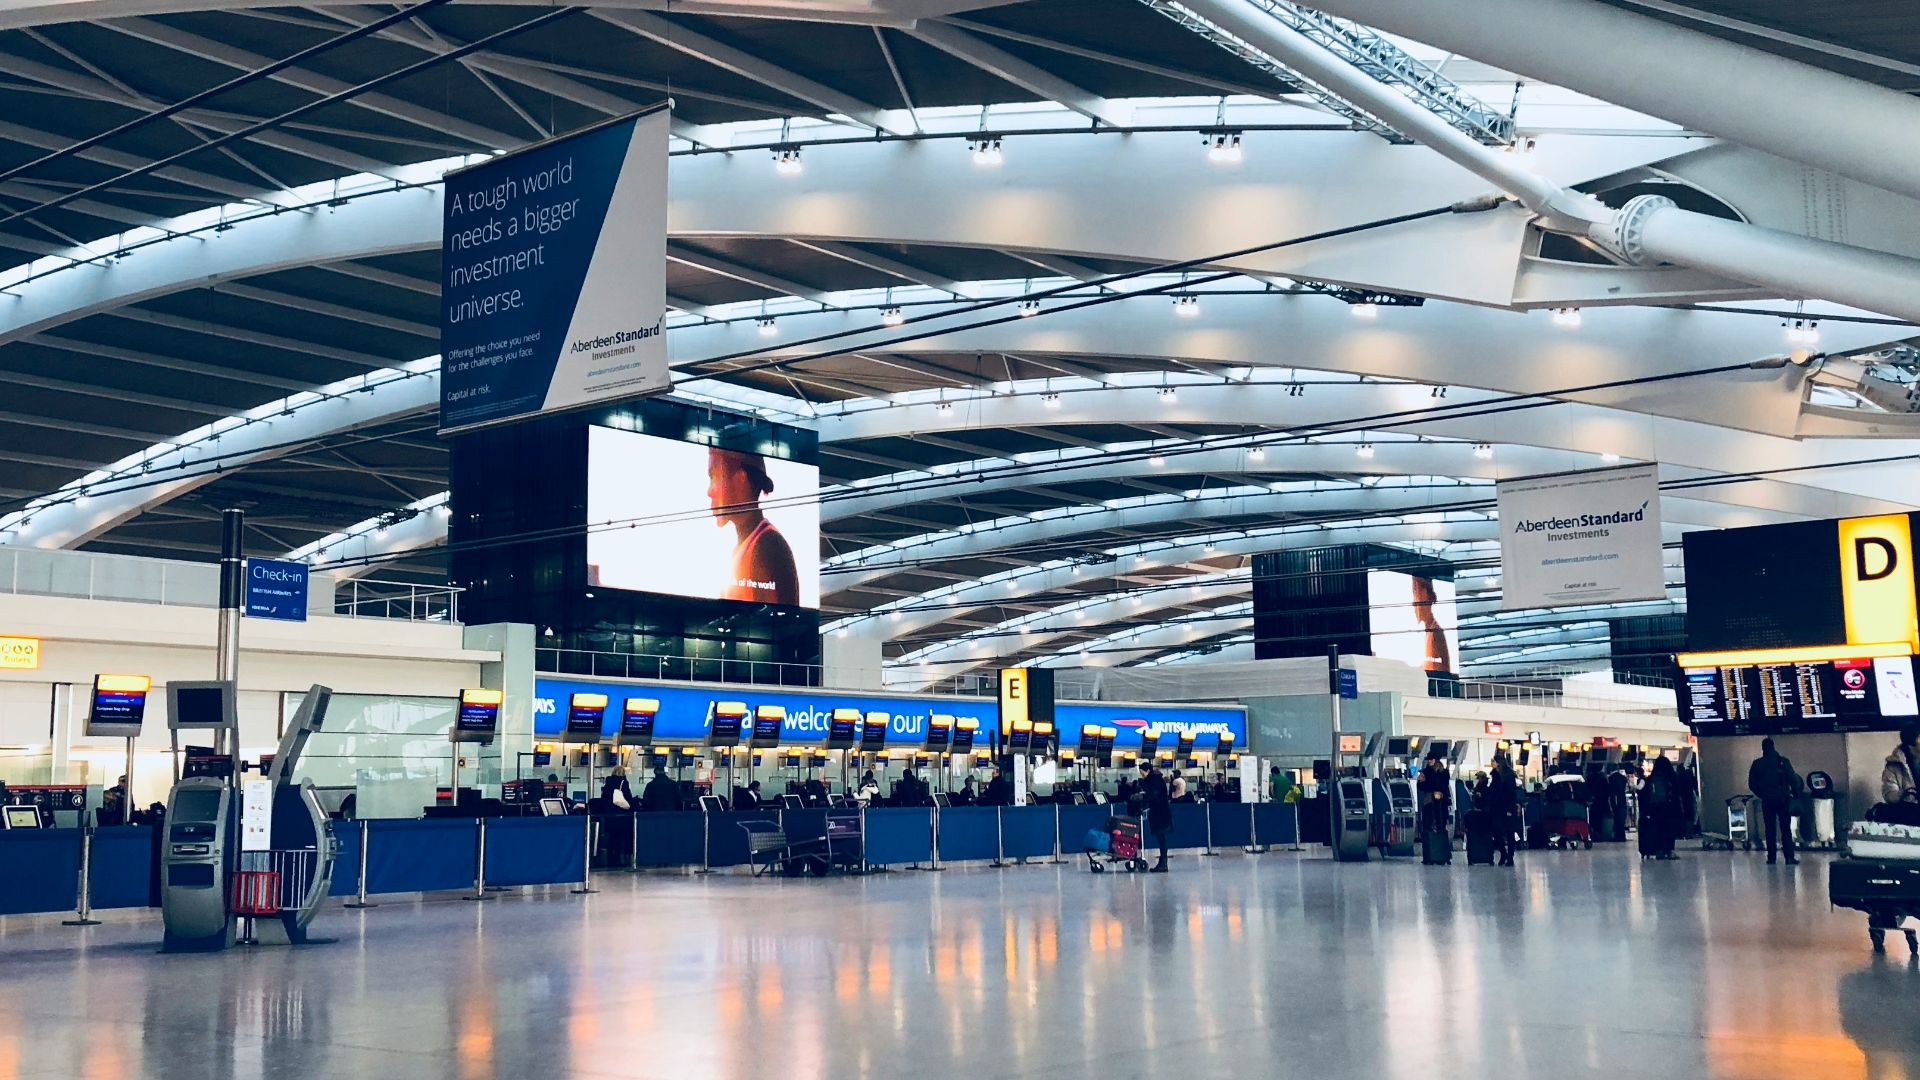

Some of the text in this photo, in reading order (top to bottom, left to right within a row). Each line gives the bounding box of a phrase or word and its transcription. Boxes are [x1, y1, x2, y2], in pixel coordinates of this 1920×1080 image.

[451, 156, 572, 217] A tough world
[451, 198, 580, 252] needs a bigger
[450, 243, 545, 288] investment
[450, 289, 524, 323] universe.
[448, 330, 541, 360] Offering the choice you need
[570, 323, 660, 355] AberdeenStandard
[448, 363, 458, 373] for
[458, 361, 469, 371] the
[470, 353, 504, 369] challenges
[505, 351, 518, 364] you
[592, 344, 636, 361] Investments
[447, 387, 469, 402] Capital
[469, 387, 477, 396] at
[1515, 508, 1643, 533] AberdeenStandard
[1547, 528, 1610, 542] Investments
[1854, 536, 1898, 582] D
[253, 565, 302, 583] Check-in
[746, 578, 757, 588] the
[758, 580, 776, 590] world
[1009, 678, 1020, 699] E
[893, 714, 925, 734] our
[1152, 721, 1188, 734] BRITISH
